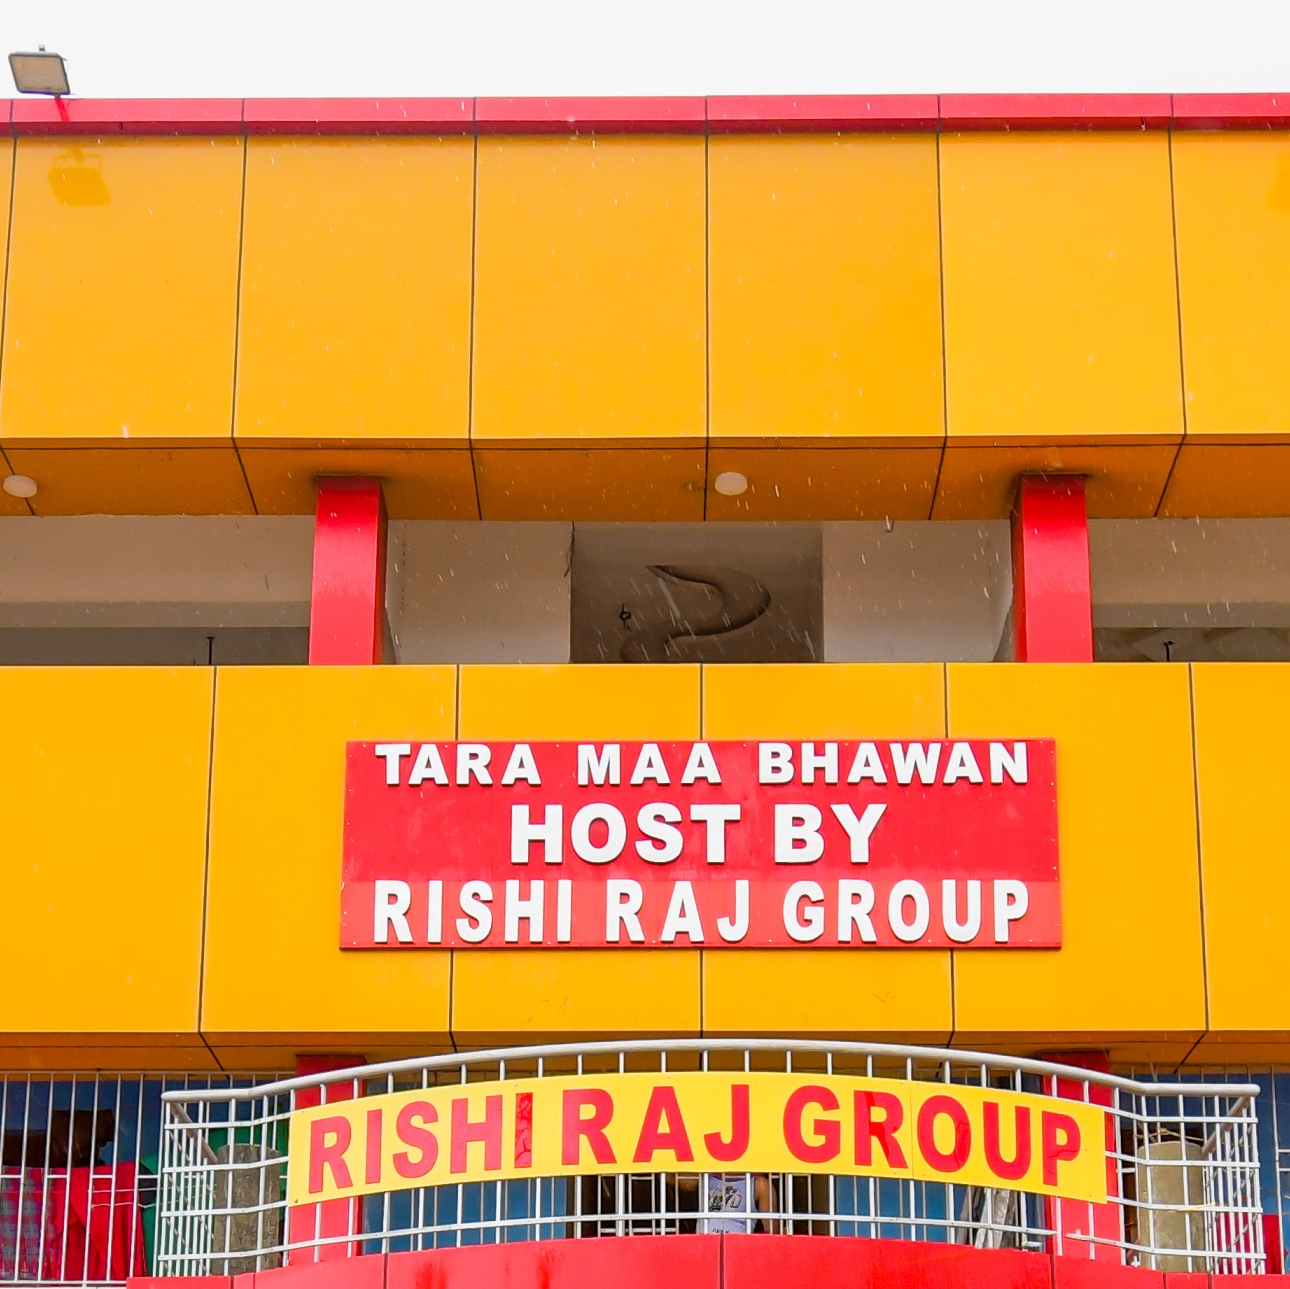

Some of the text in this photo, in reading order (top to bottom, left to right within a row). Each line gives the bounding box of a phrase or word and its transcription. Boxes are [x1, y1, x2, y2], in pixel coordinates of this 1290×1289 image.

[374, 741, 1029, 786] TARA MAA BHAWAN
[510, 803, 887, 864] HOST BY
[372, 879, 1030, 944] RISHI RAJ GROUP
[310, 1083, 1082, 1194] RISHI RAJ GROUP
